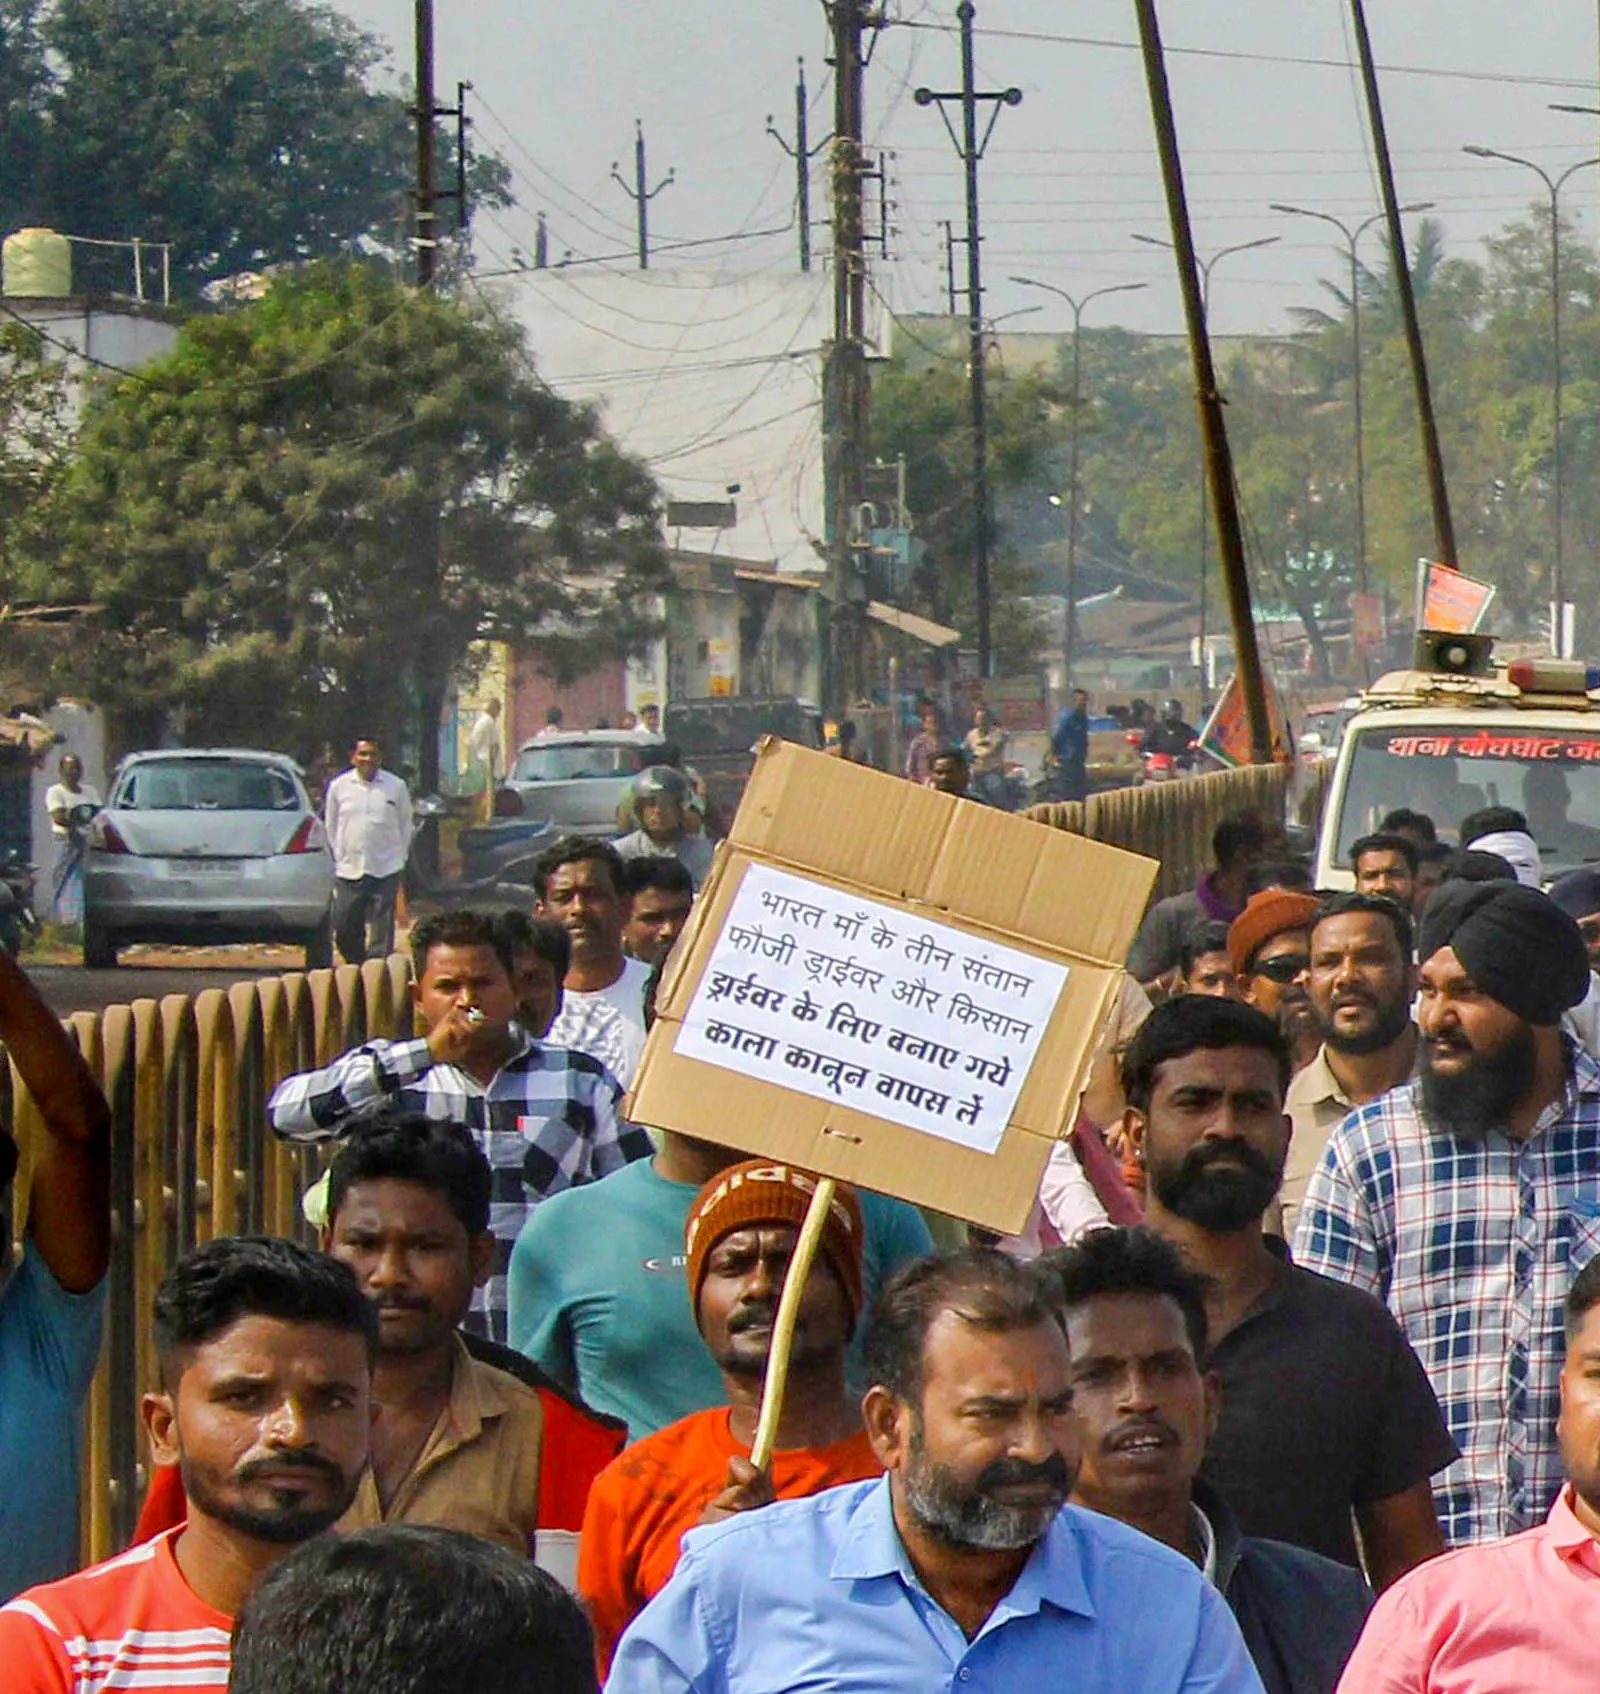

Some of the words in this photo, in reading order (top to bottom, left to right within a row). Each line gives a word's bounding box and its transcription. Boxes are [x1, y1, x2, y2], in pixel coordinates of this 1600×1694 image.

[1387, 736, 1453, 757] थाना
[728, 925, 797, 968] फौजी
[803, 948, 884, 995] ड्राईवर
[892, 977, 940, 1015] और
[947, 991, 1033, 1044] किसान
[761, 890, 824, 931] भारत
[833, 911, 867, 942] माँ
[872, 920, 898, 951] के
[905, 936, 955, 971] तीन
[962, 953, 1035, 998] संतान
[704, 1020, 779, 1061] काला
[784, 1047, 869, 1095] कानून
[875, 1074, 949, 1118] वापस
[957, 1093, 985, 1128] लें
[706, 970, 784, 1012] ड्राईवर
[792, 992, 822, 1024] के
[829, 1001, 883, 1046] लिए
[887, 1027, 958, 1073] बनाए
[965, 1054, 1014, 1088] गये
